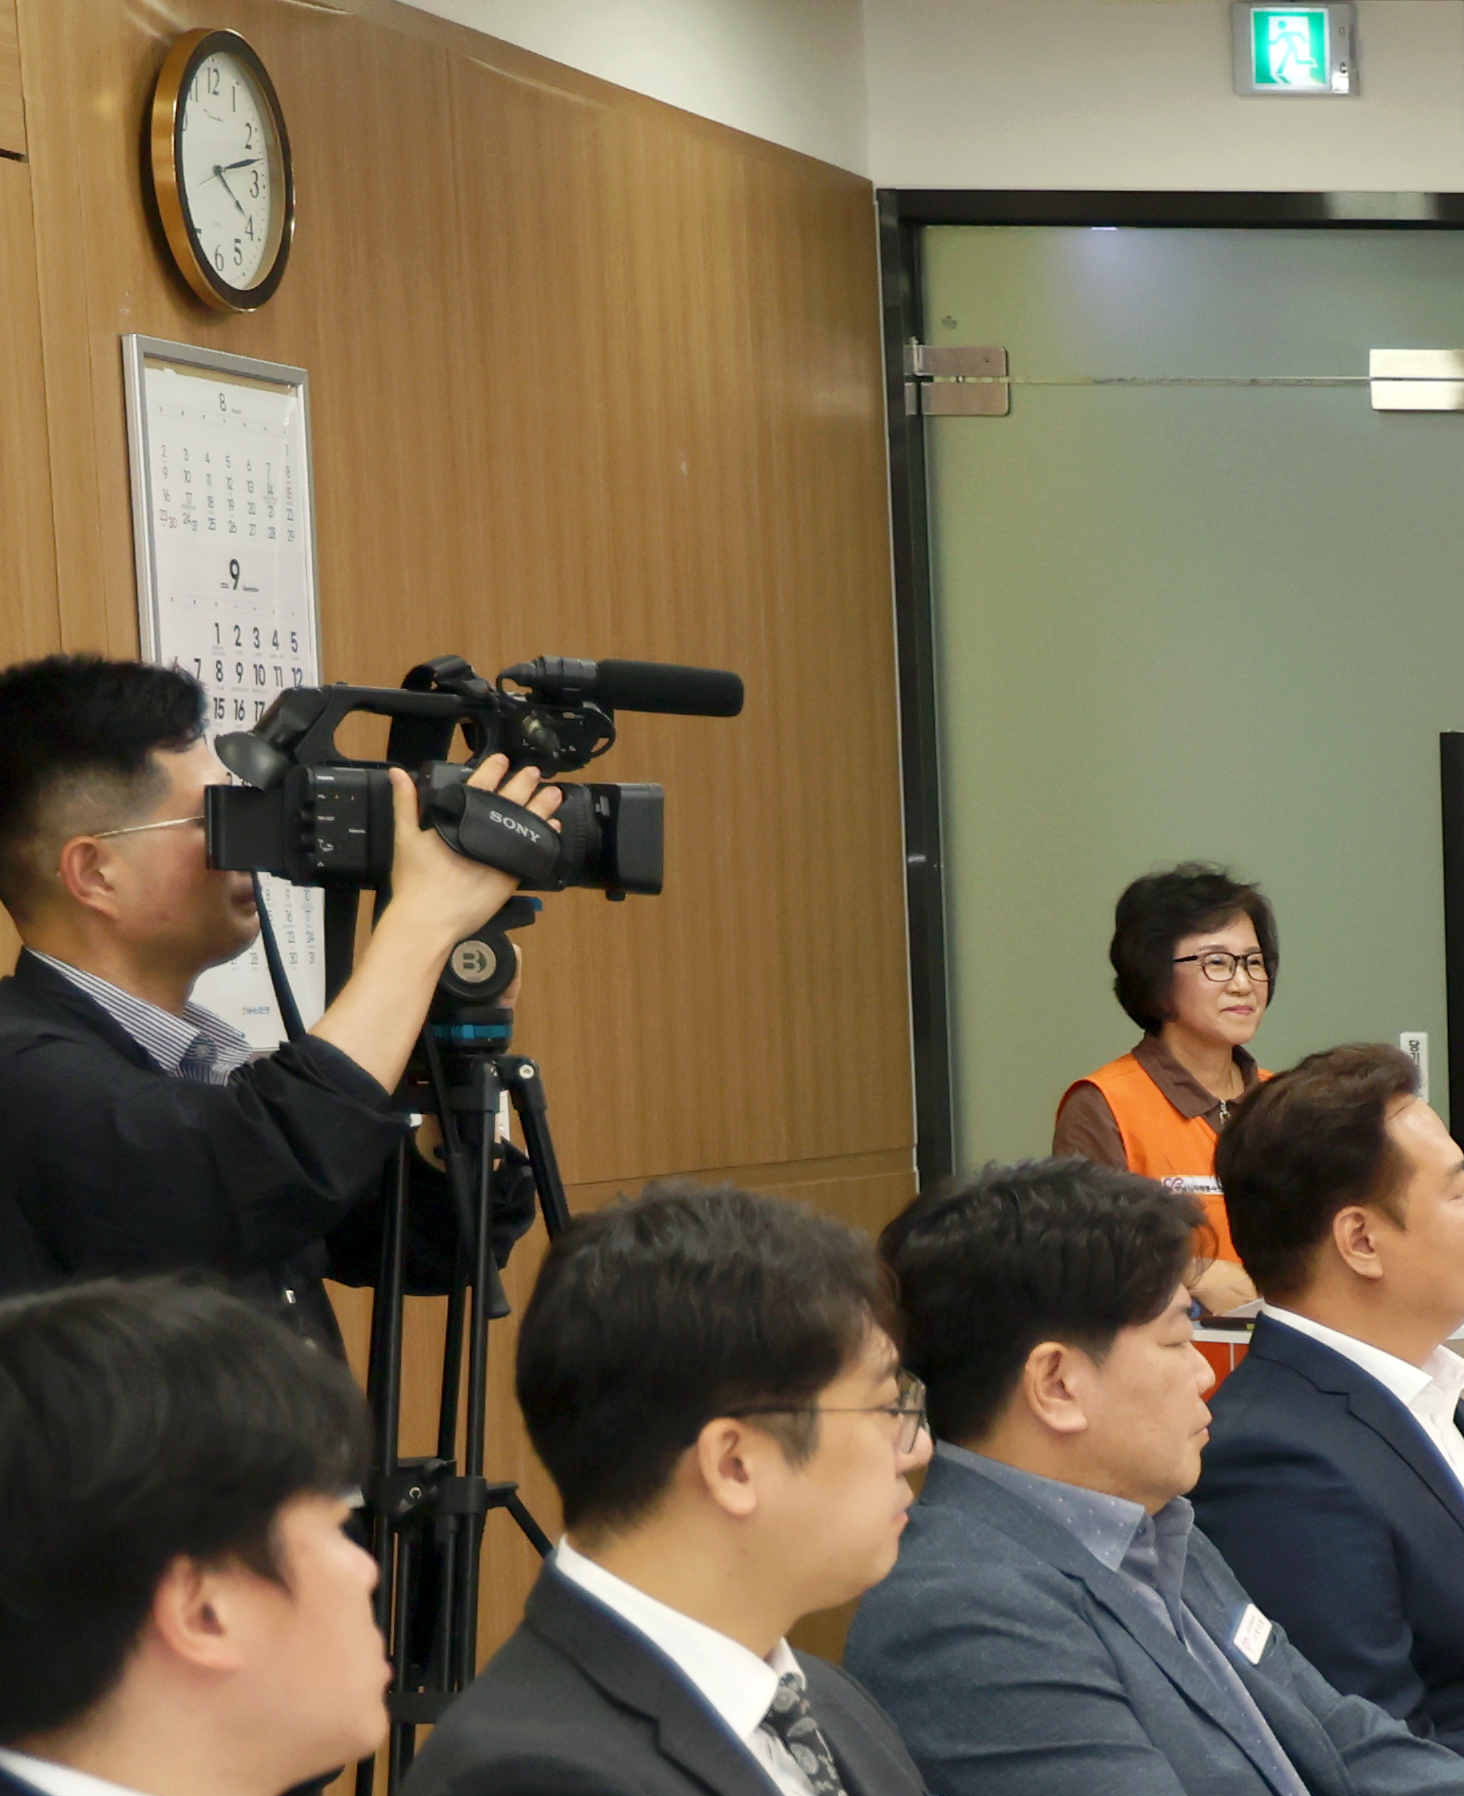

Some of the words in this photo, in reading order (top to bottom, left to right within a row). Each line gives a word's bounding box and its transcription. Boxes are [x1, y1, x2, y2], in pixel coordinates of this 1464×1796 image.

[207, 67, 220, 96] 12
[231, 86, 237, 112] 1
[244, 122, 253, 150] 2
[250, 169, 259, 198] 3
[244, 215, 254, 241] 4
[214, 244, 224, 271] 6
[233, 238, 243, 266] 5
[219, 392, 227, 412] 8
[229, 558, 240, 590] 9
[214, 622, 221, 645] 1
[234, 624, 242, 647] 2
[253, 626, 260, 649] 3
[272, 630, 280, 650] 4
[291, 631, 298, 653] 5
[215, 659, 224, 683] 8
[235, 662, 243, 684] 9
[253, 663, 266, 686] 10
[273, 665, 284, 688] 11
[213, 697, 225, 720] 15
[233, 698, 245, 721] 16
[489, 810, 540, 843] SONY
